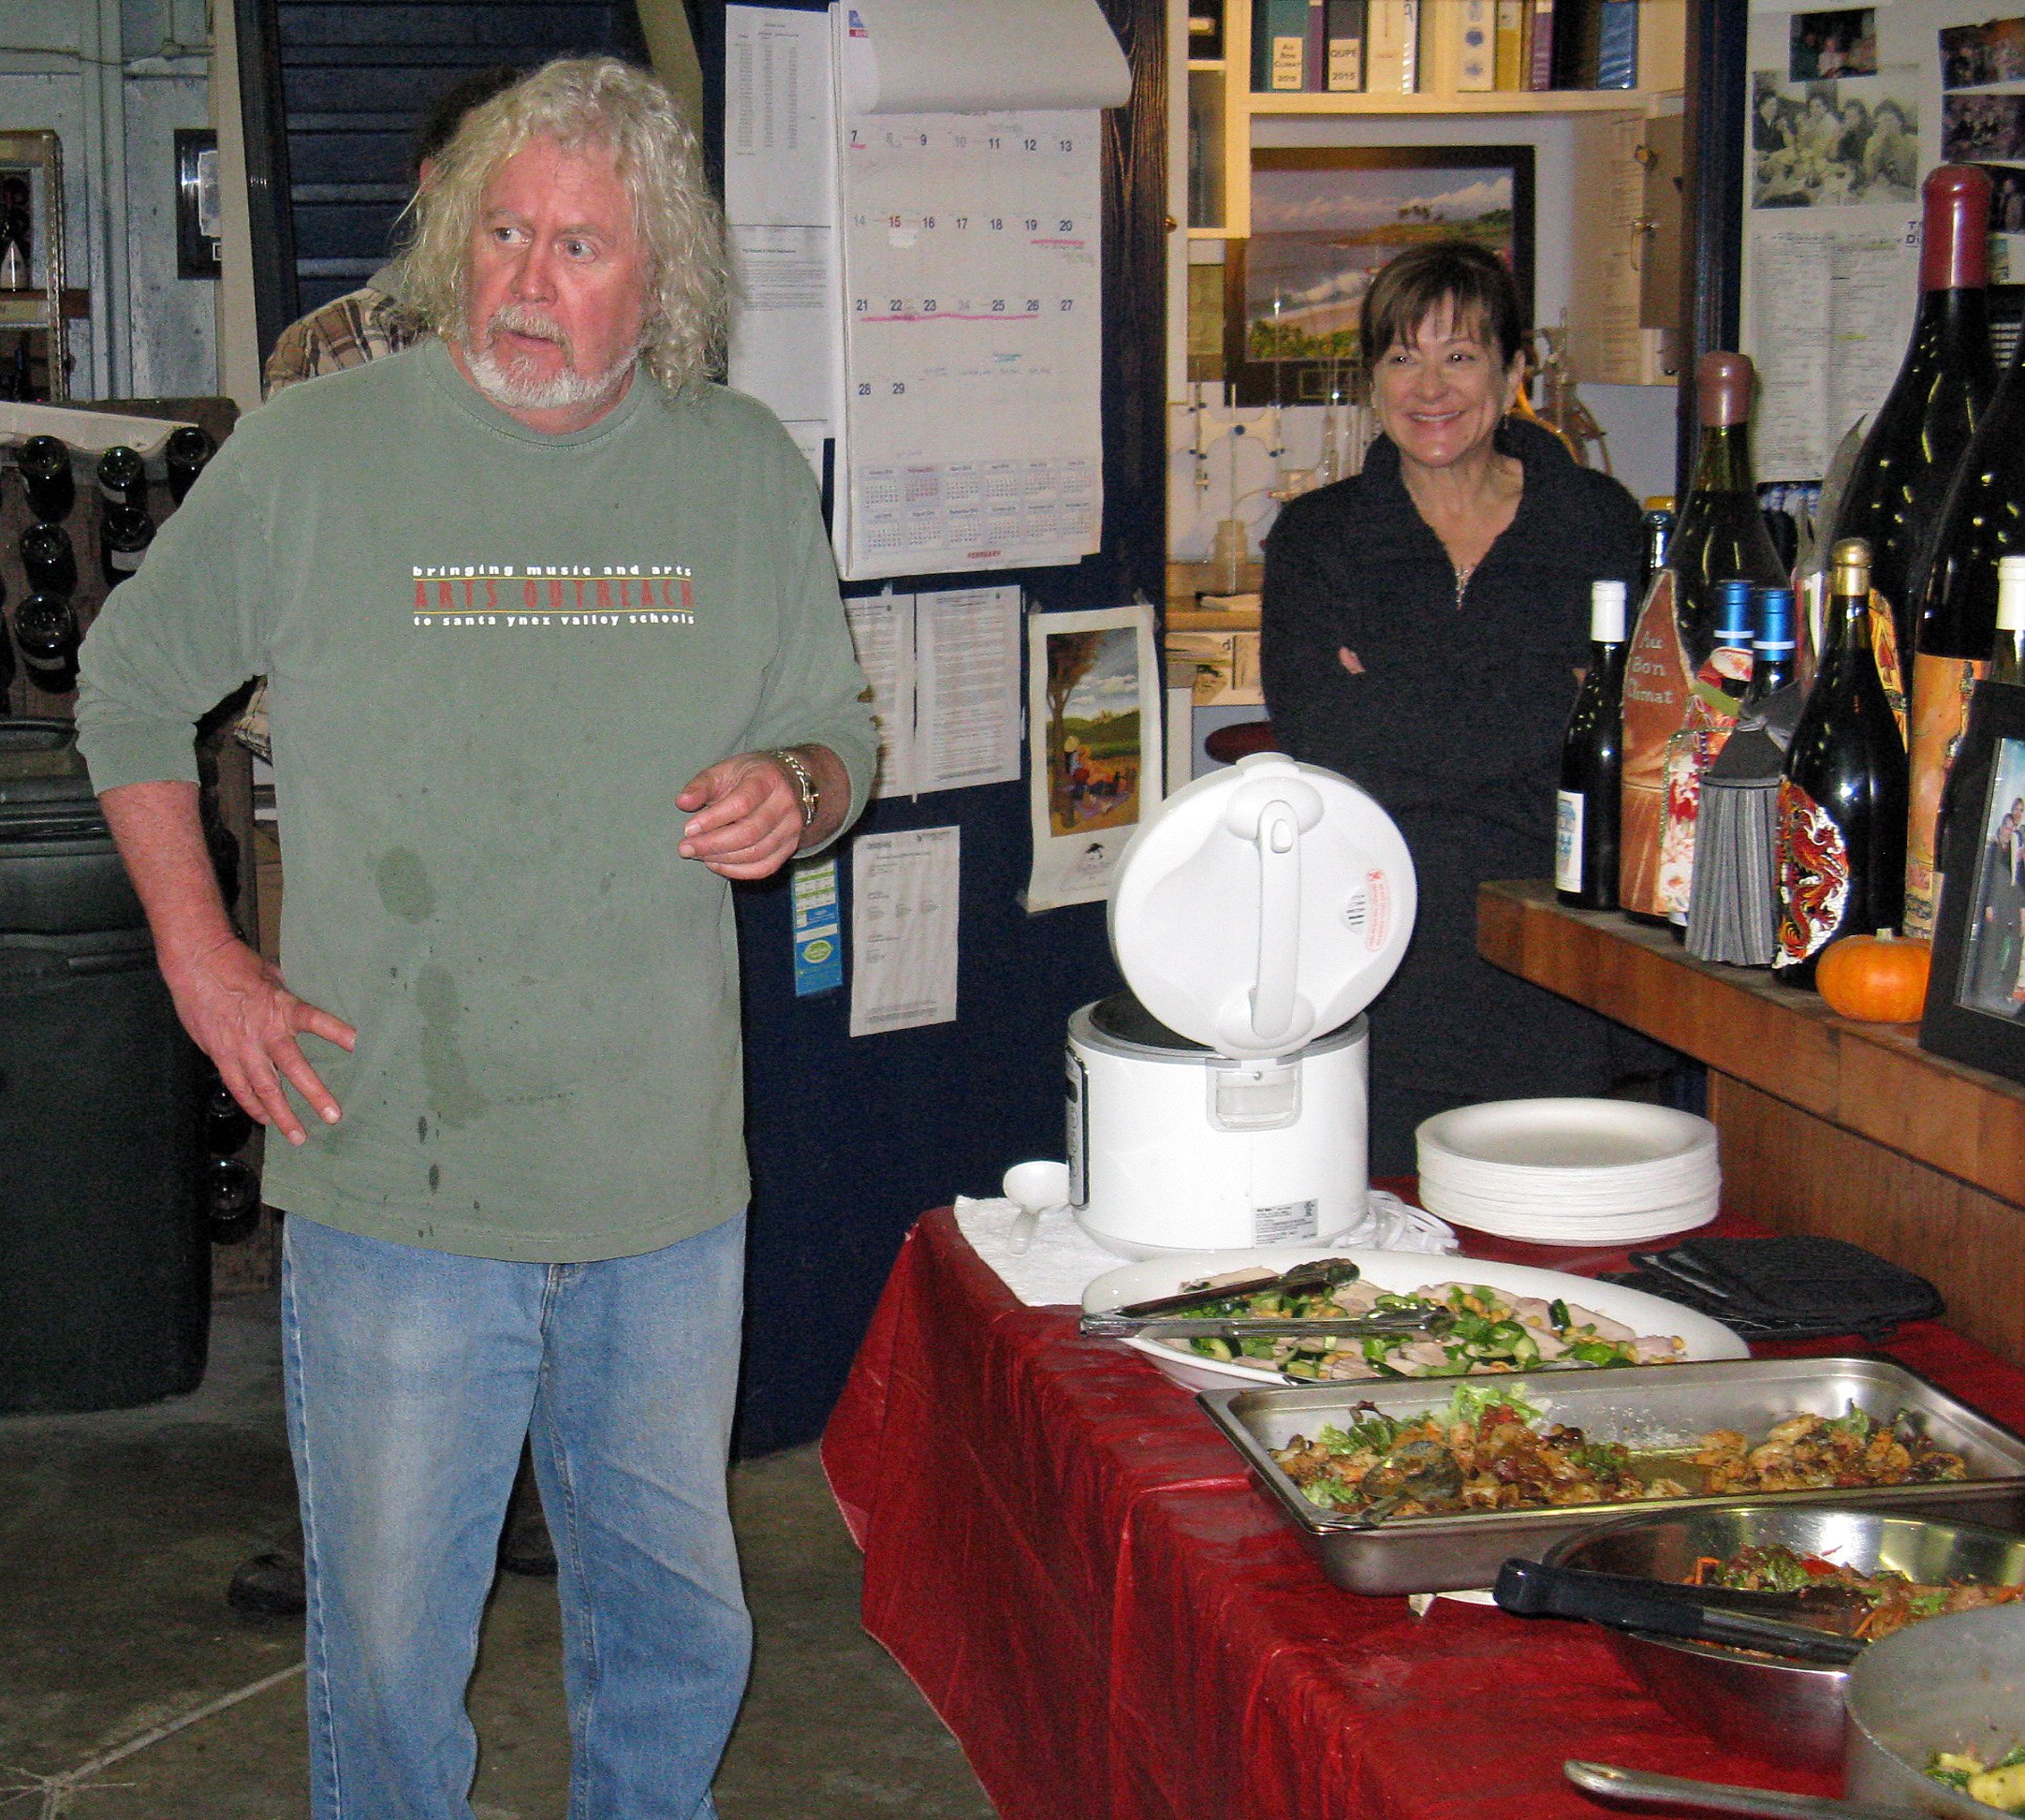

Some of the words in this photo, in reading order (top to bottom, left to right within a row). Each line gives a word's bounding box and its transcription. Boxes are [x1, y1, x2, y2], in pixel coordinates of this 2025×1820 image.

[1332, 72, 1356, 81] 2015
[850, 129, 858, 143] 7
[919, 133, 928, 146] 9
[988, 137, 1001, 150] 11
[1023, 139, 1037, 151] 12
[1059, 140, 1073, 152] 13
[889, 215, 902, 228] 15
[922, 216, 935, 228] 16
[956, 217, 968, 229] 17
[990, 218, 1004, 230] 18
[1025, 219, 1037, 231] 19
[1059, 220, 1073, 231] 20
[856, 299, 869, 312] 21
[889, 299, 902, 312] 22
[923, 299, 937, 312] 23
[991, 299, 1005, 312] 25
[1026, 299, 1040, 312] 26
[1060, 299, 1074, 312] 27
[858, 383, 872, 396] 28
[892, 382, 906, 395] 29
[412, 564, 514, 577] bringing
[526, 564, 592, 576] music
[603, 565, 640, 576] and
[651, 565, 692, 577] arts
[414, 580, 499, 609] ARTS
[523, 579, 695, 609] OUTREACH
[414, 616, 433, 627] to
[442, 615, 496, 626] santa
[506, 615, 550, 628] ynez
[561, 614, 619, 626] valley
[628, 612, 695, 626] schools
